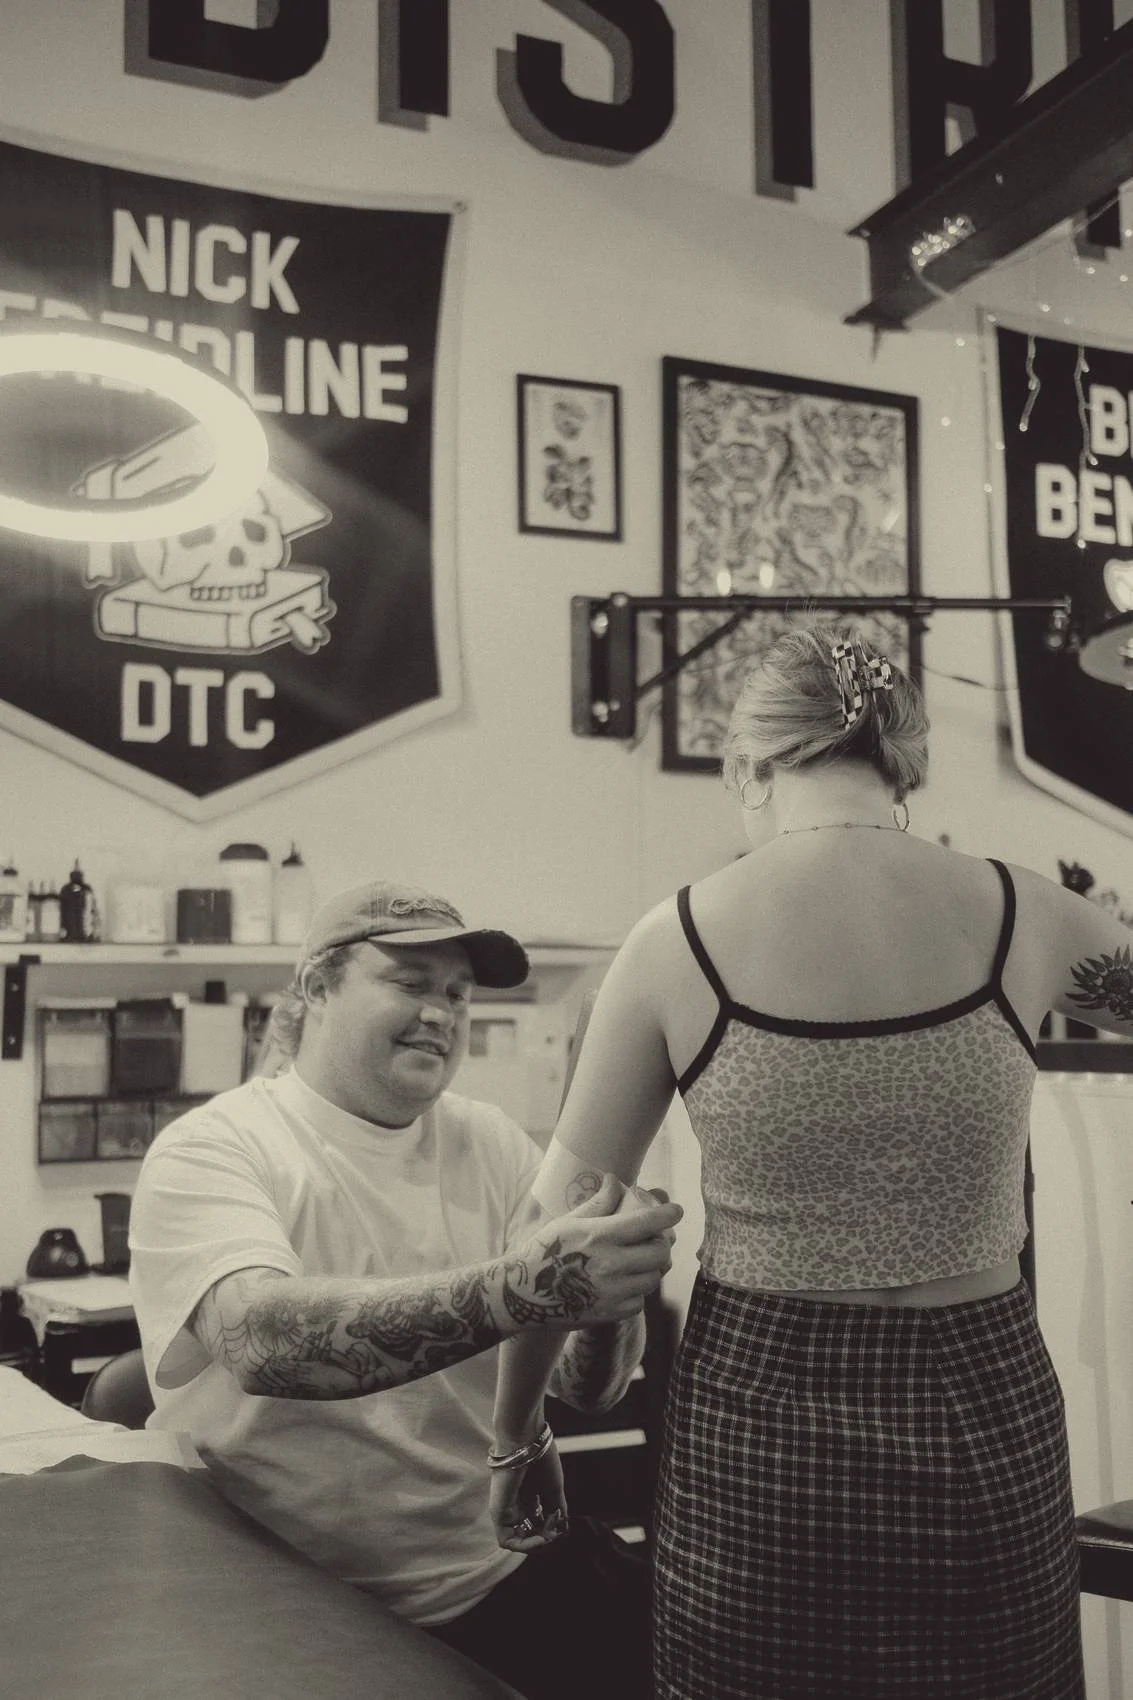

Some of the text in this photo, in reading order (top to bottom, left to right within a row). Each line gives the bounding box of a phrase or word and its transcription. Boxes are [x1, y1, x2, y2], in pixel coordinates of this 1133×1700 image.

[112, 208, 301, 314] NICK
[0, 290, 409, 424] DLINE
[1089, 383, 1133, 457] B
[121, 662, 275, 749] DTC
